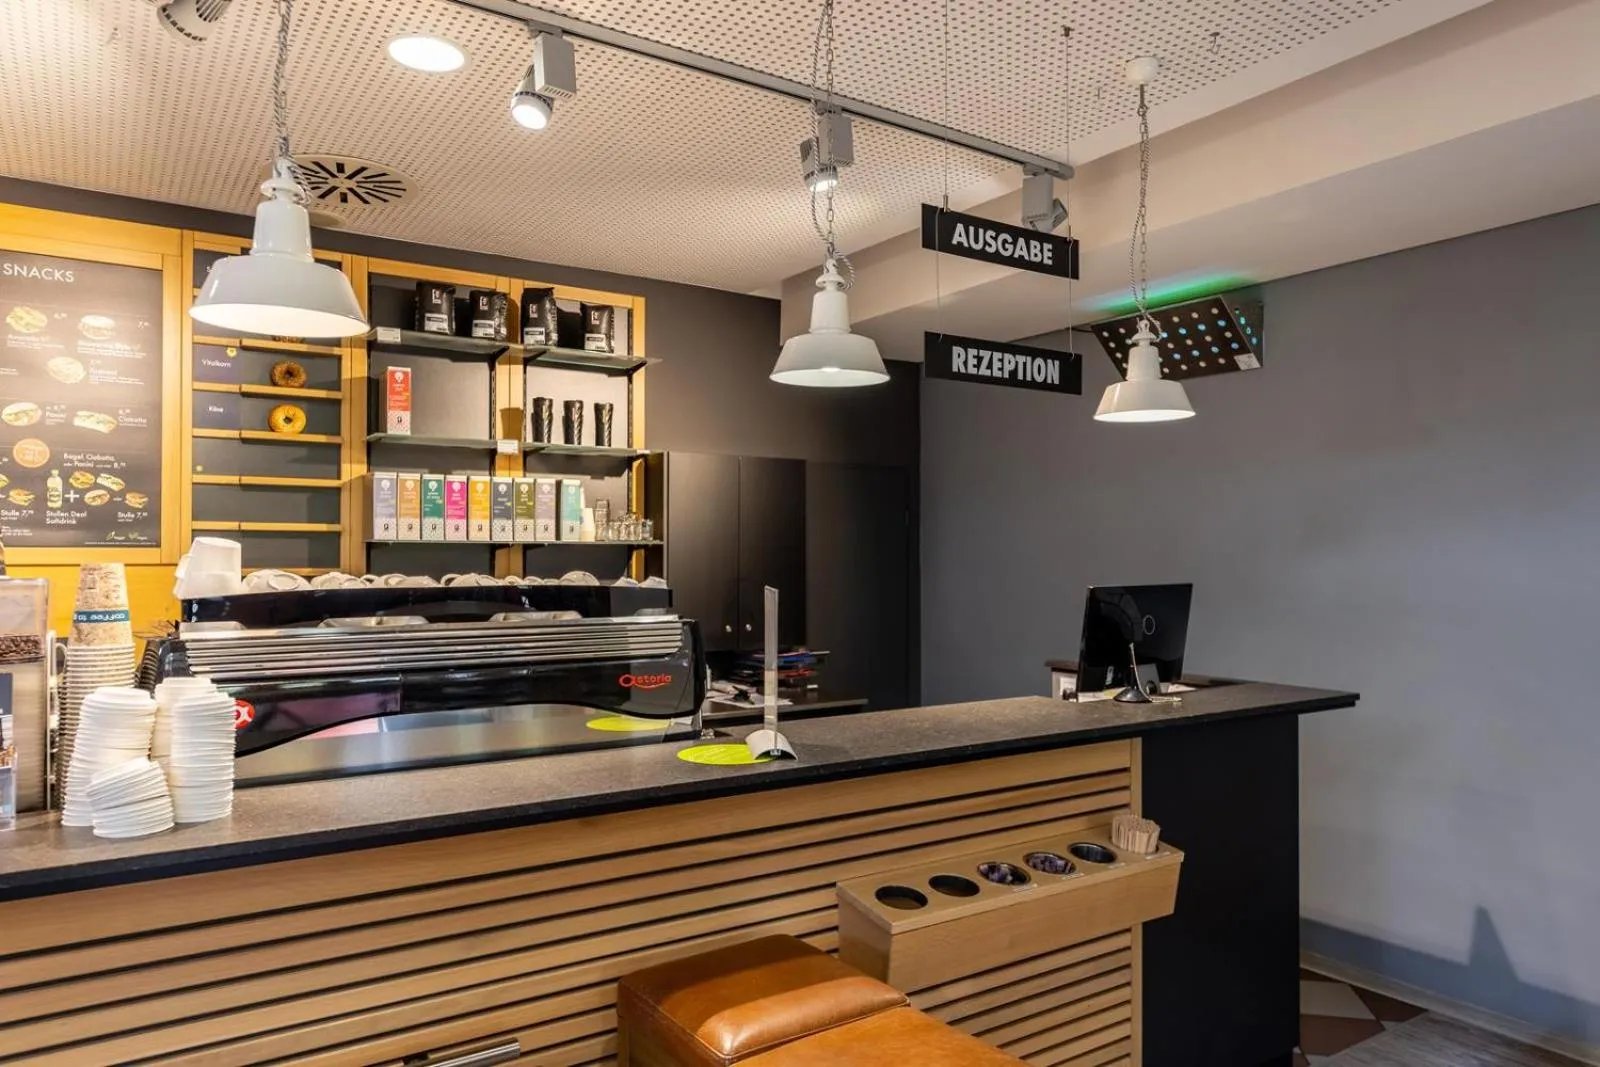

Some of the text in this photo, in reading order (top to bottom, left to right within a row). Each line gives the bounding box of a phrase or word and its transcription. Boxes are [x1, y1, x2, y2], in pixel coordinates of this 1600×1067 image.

[952, 222, 1053, 265] AUSGABE
[3, 262, 75, 283] SNACKS
[951, 345, 1060, 385] REZEPTION
[90, 612, 125, 621] coffee
